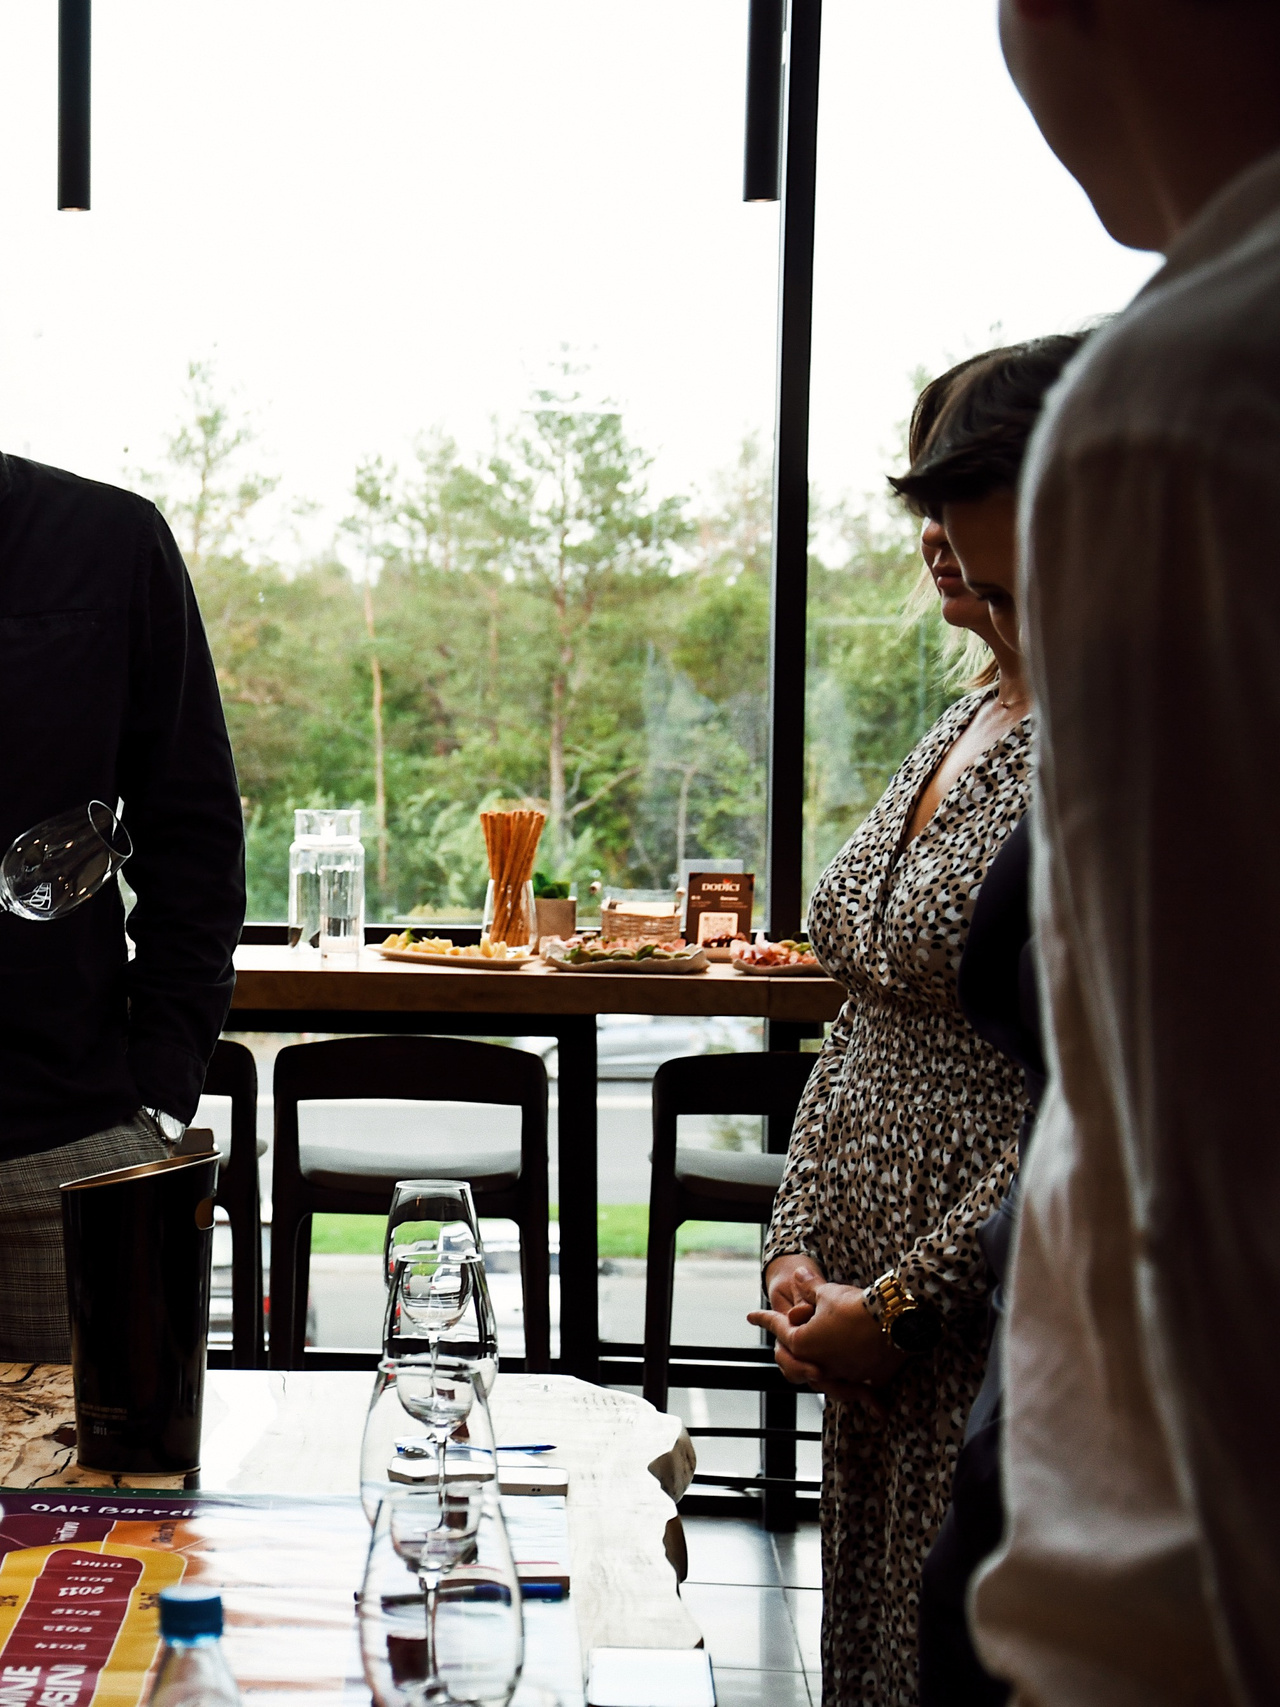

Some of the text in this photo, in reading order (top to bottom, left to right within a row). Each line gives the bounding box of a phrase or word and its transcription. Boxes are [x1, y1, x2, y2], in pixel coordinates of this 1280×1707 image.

[30, 1503, 91, 1513] OAK
[58, 1586, 105, 1597] 2011
[51, 1608, 102, 1616] 2012
[43, 1625, 93, 1633] 2013
[35, 1642, 86, 1651] 2014
